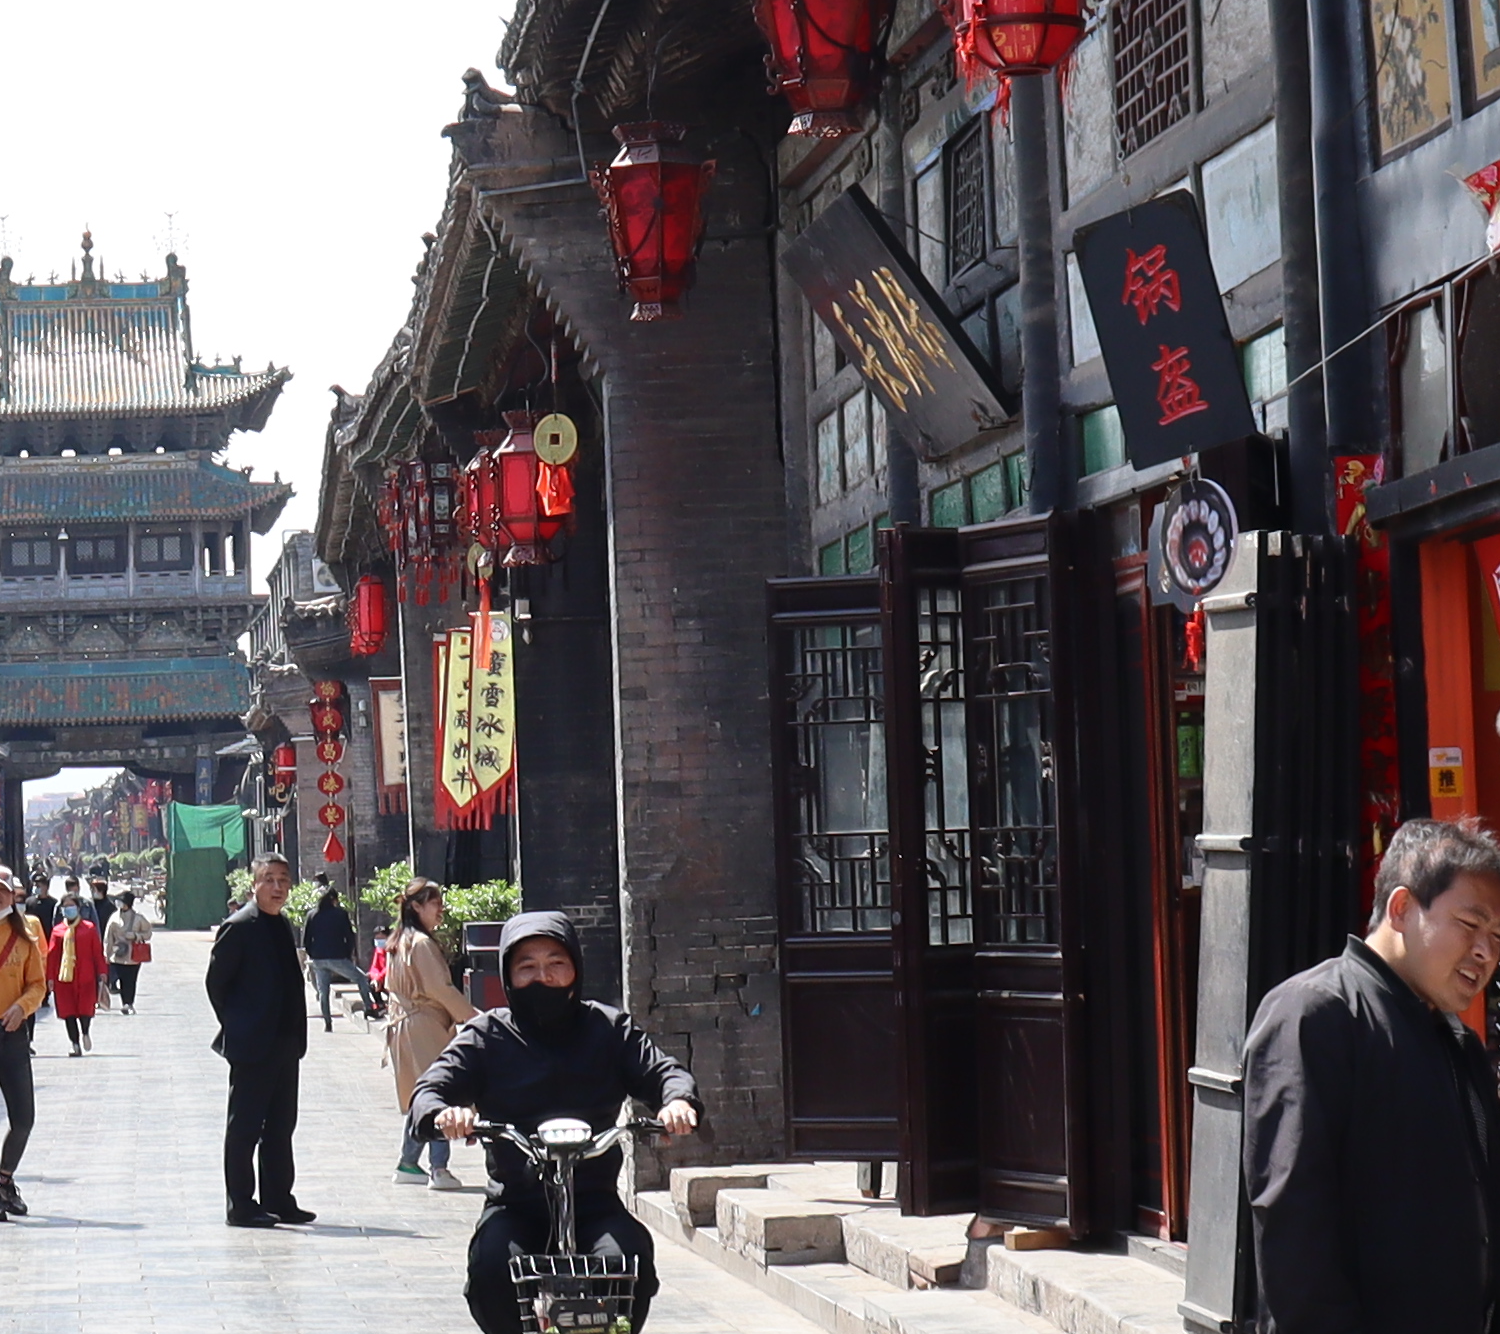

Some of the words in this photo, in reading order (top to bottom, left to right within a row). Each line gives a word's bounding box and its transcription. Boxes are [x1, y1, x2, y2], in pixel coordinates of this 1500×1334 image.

[1121, 244, 1209, 426] 锅盔
[473, 650, 506, 774] 蜜雪冰城
[1438, 769, 1456, 787] 推
